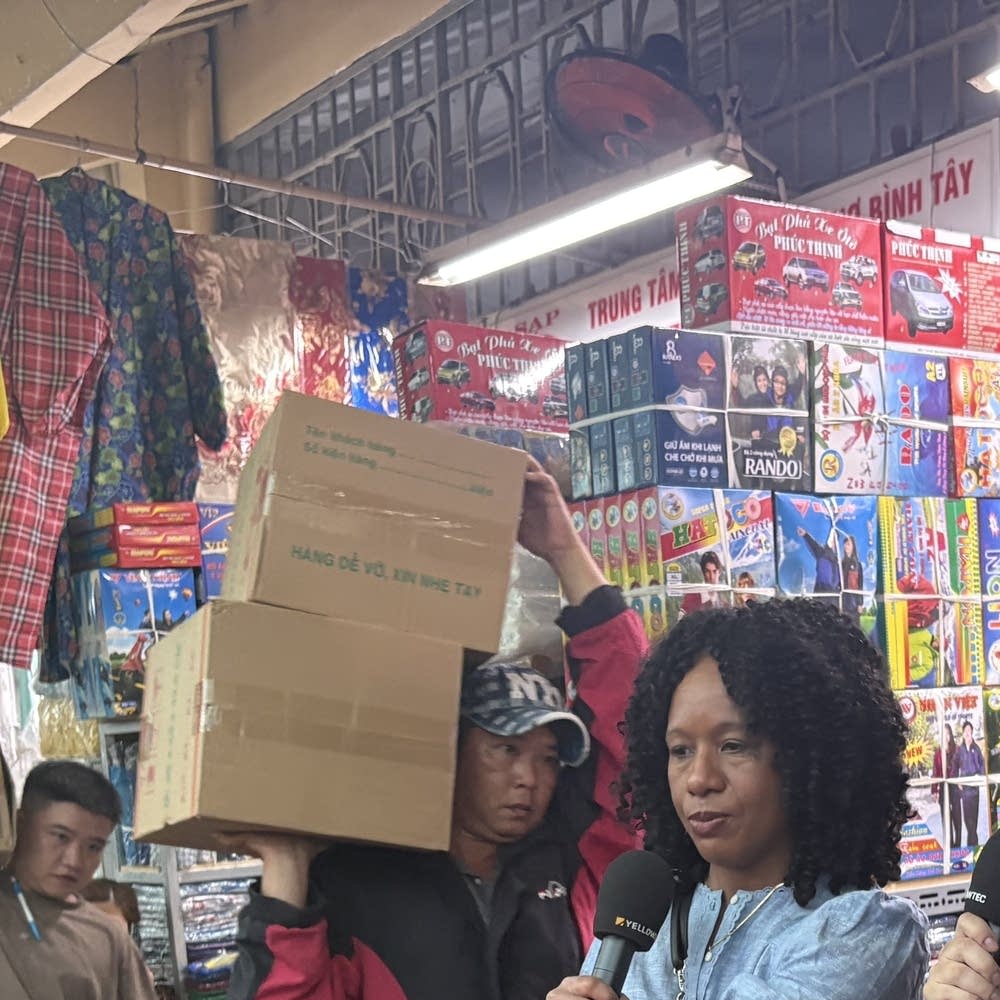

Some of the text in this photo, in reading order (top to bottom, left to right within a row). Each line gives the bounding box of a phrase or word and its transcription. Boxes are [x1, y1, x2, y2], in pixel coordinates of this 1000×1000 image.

[930, 158, 975, 206] TÂY
[774, 235, 844, 260] PHÚC THỊNH
[891, 239, 920, 258] PHÚC
[587, 266, 682, 330] TRUNG TÂM
[664, 453, 680, 462] CHE
[745, 458, 799, 477] RANDO
